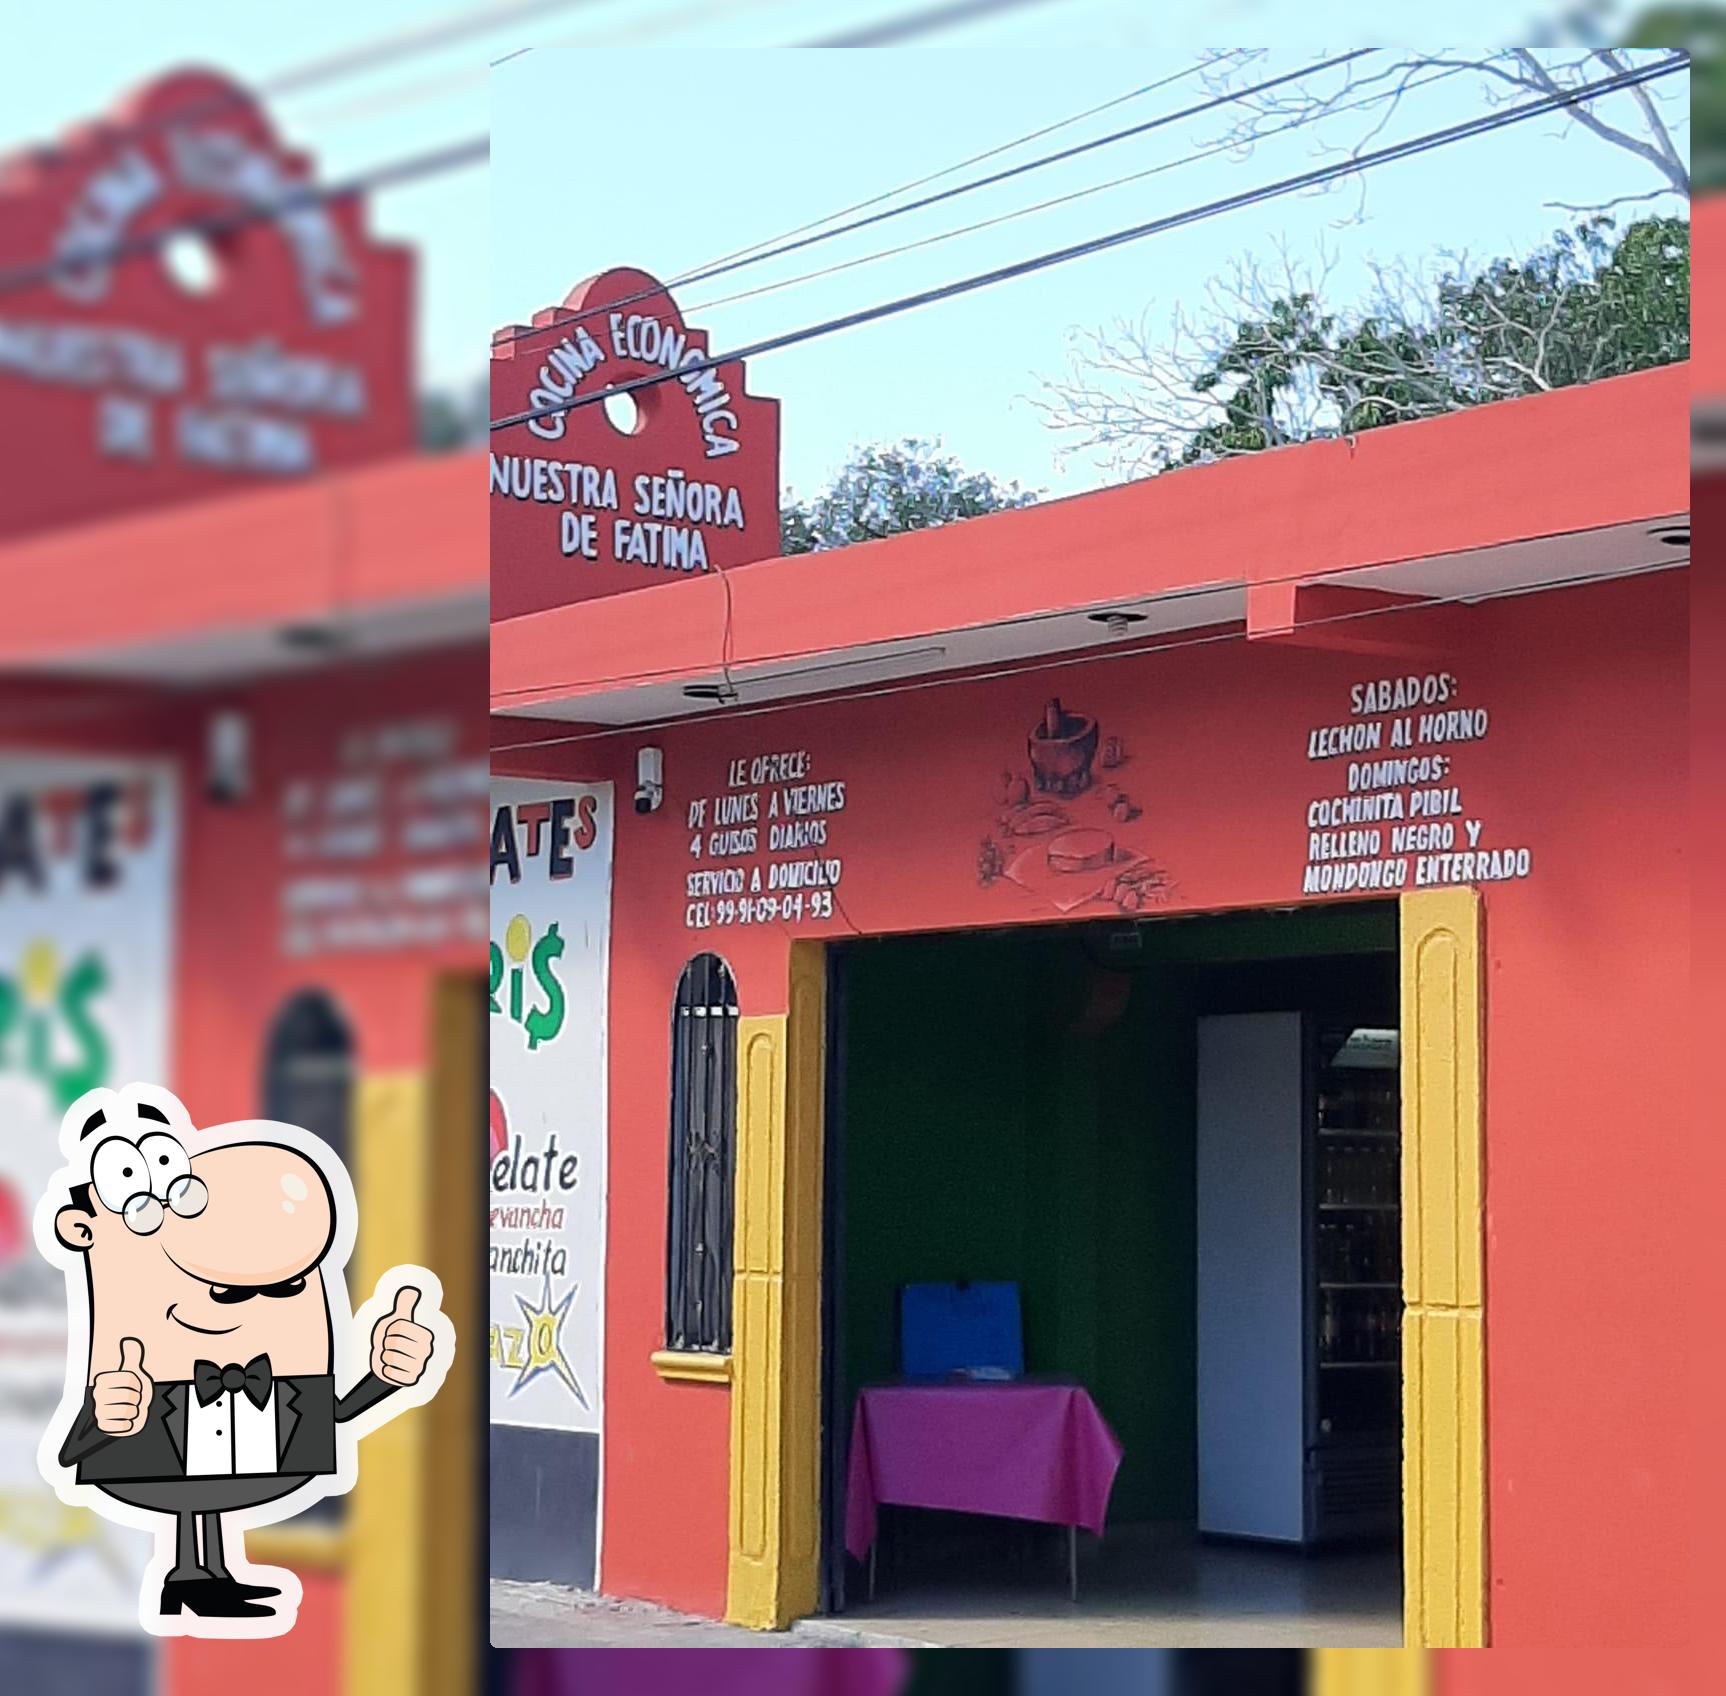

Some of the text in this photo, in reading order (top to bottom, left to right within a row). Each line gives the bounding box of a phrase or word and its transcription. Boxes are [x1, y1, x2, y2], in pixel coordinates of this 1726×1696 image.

[528, 312, 741, 459] COCINA ECONOMICA
[490, 453, 745, 529] NUESTRA SEÑORA
[560, 511, 710, 571] DE FATIMA
[1351, 672, 1457, 715] SABADOS:
[1308, 709, 1488, 759] LECHON AL HORNO
[729, 759, 748, 787] LE
[1348, 755, 1450, 793] DOMINGOS:
[714, 792, 759, 827] LUNES
[768, 791, 779, 819] A
[784, 782, 845, 816] VIERNES
[1308, 788, 1462, 829] COCHINITA PIBIL
[690, 820, 828, 859] 4 GUISOS DIARIOS
[1309, 820, 1481, 861] RELLENO NEGRO Y
[687, 860, 841, 898] SERVICIO A DOMICILIO
[1303, 848, 1531, 895] MONDONGO ENTERRADO
[491, 1134, 579, 1193] elate
